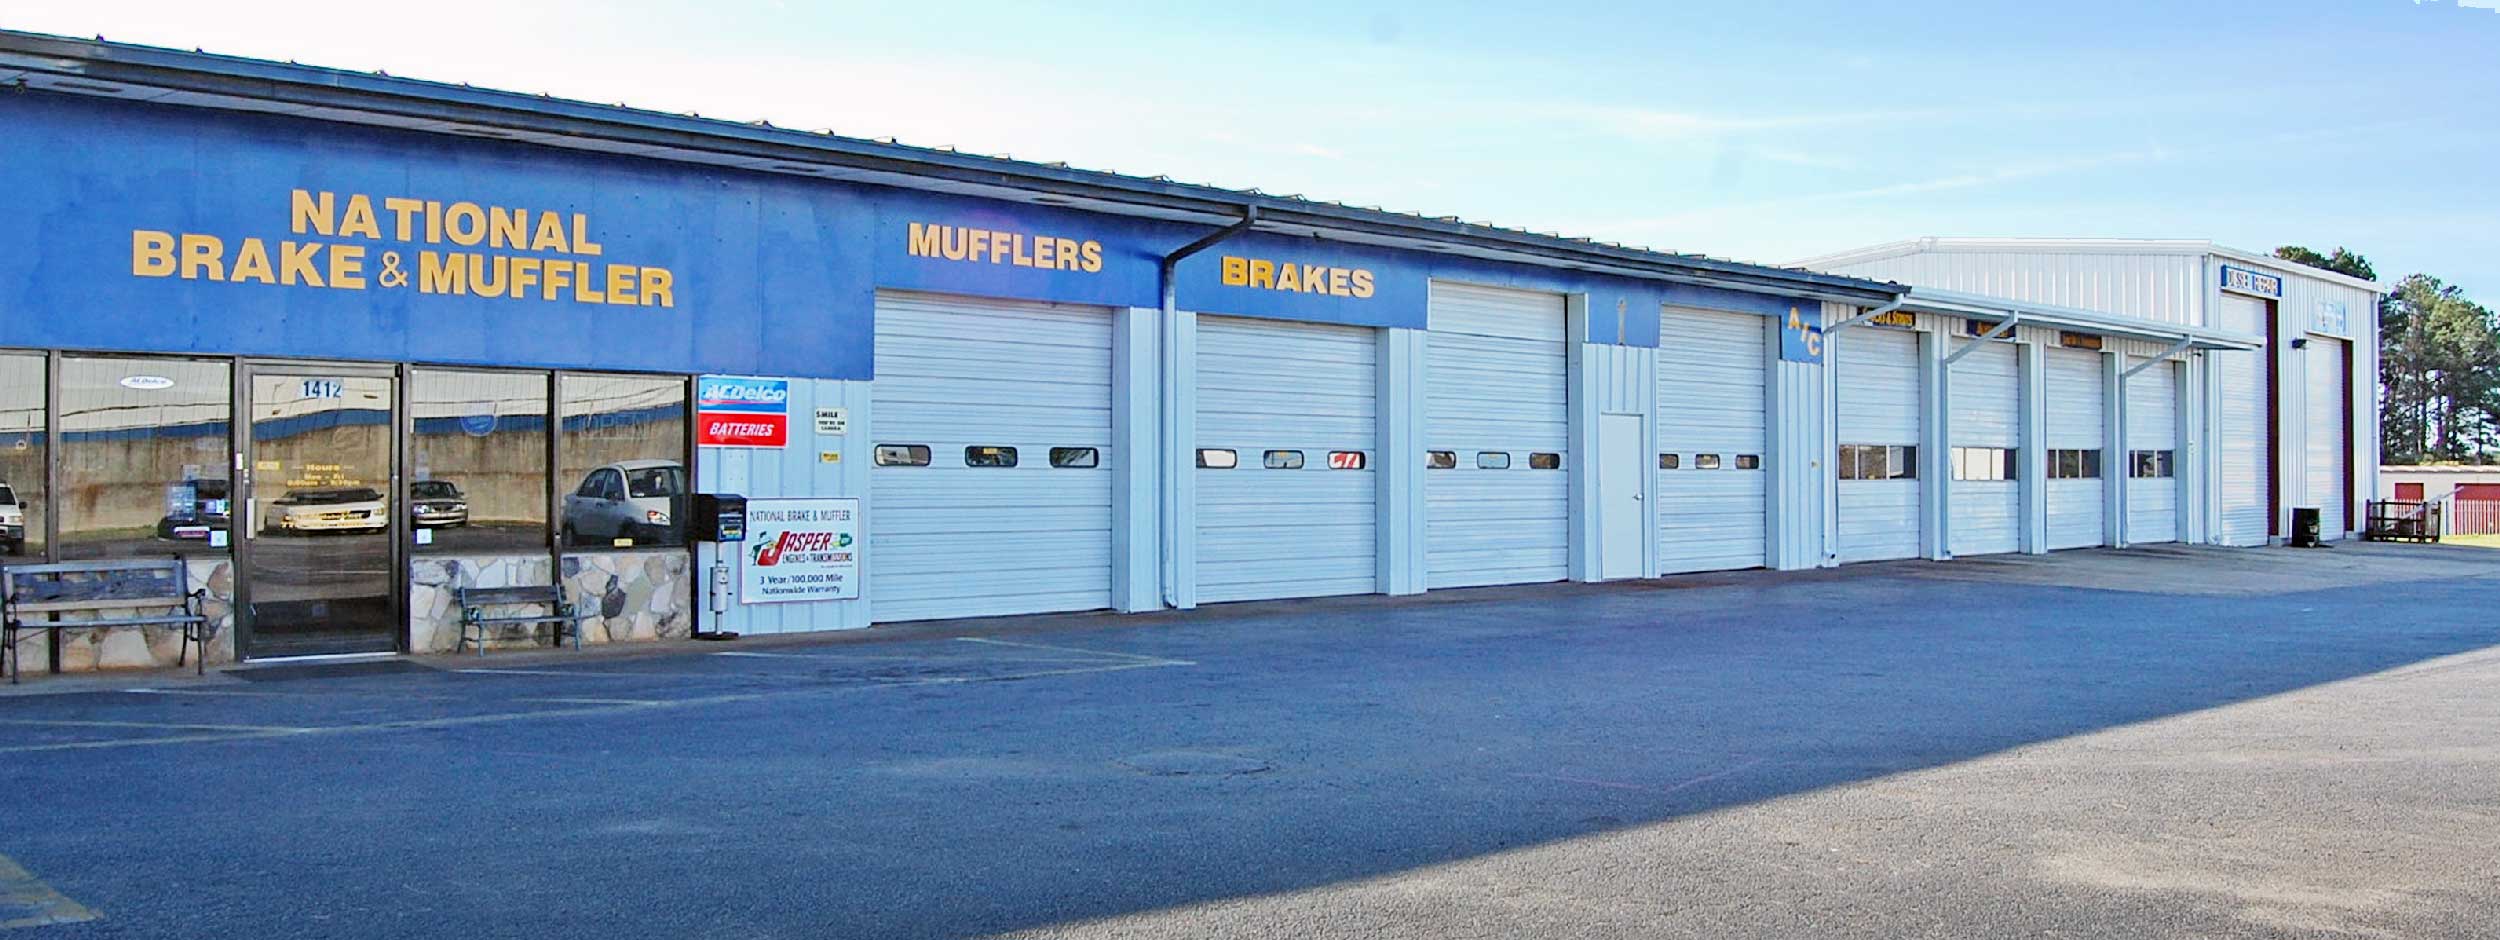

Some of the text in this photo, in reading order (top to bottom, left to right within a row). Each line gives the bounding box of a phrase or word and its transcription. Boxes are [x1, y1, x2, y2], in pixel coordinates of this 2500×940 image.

[290, 188, 602, 256] NATIONAL
[907, 222, 1103, 274] MUFFLERS
[132, 230, 675, 308] BRAKE & MUFFLER
[1221, 256, 1375, 299] BRAKES
[1787, 306, 1820, 356] A/C
[303, 380, 343, 398] 1412
[704, 384, 786, 401] ACDelco
[709, 422, 775, 437] BATTERIES
[750, 510, 785, 521] NATIONAL
[787, 510, 811, 521] BRAKE
[821, 510, 850, 521] MUFFLER
[757, 531, 832, 566] JASPER
[760, 576, 765, 585] 3
[826, 574, 843, 583] Mile
[762, 585, 841, 595] Nationwide Warranty
